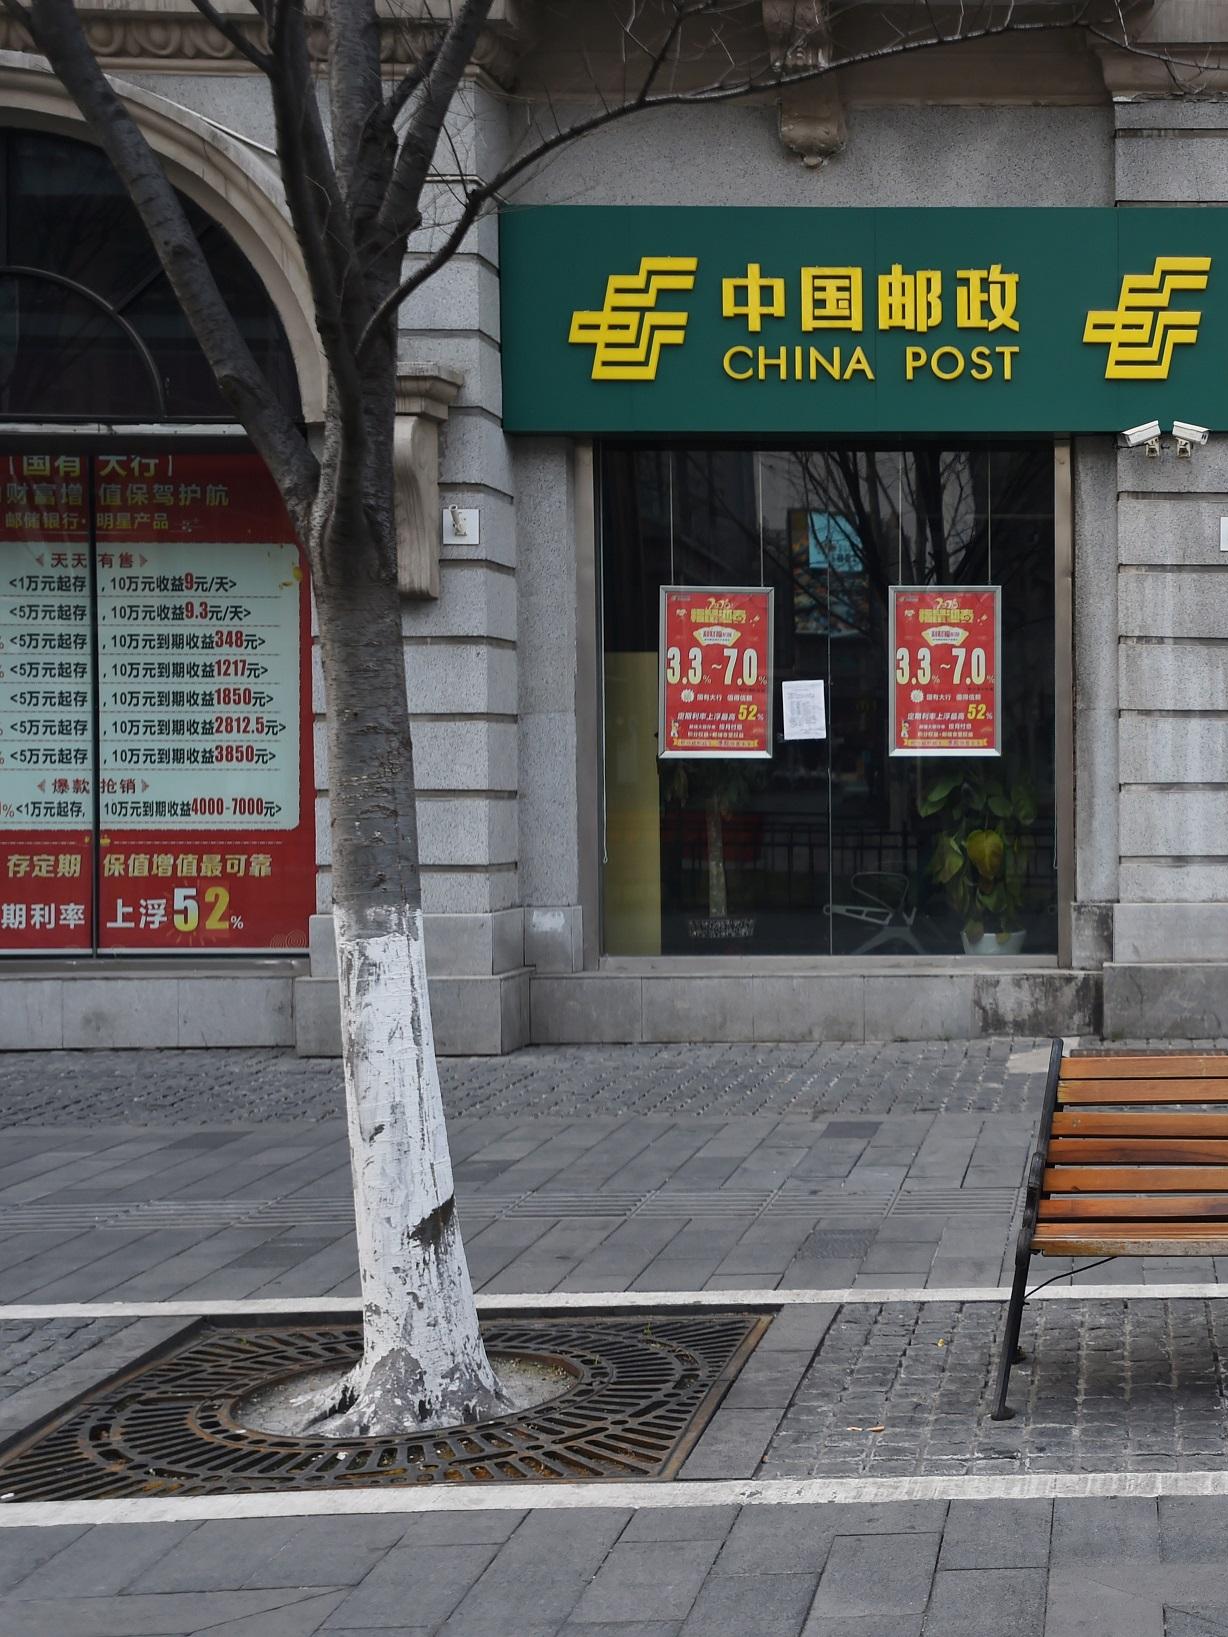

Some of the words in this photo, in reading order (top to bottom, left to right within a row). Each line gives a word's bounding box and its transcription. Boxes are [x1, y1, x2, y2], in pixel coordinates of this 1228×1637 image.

[722, 263, 1020, 332] 中国邮政
[723, 345, 875, 380] CHINA
[906, 346, 1019, 380] POST
